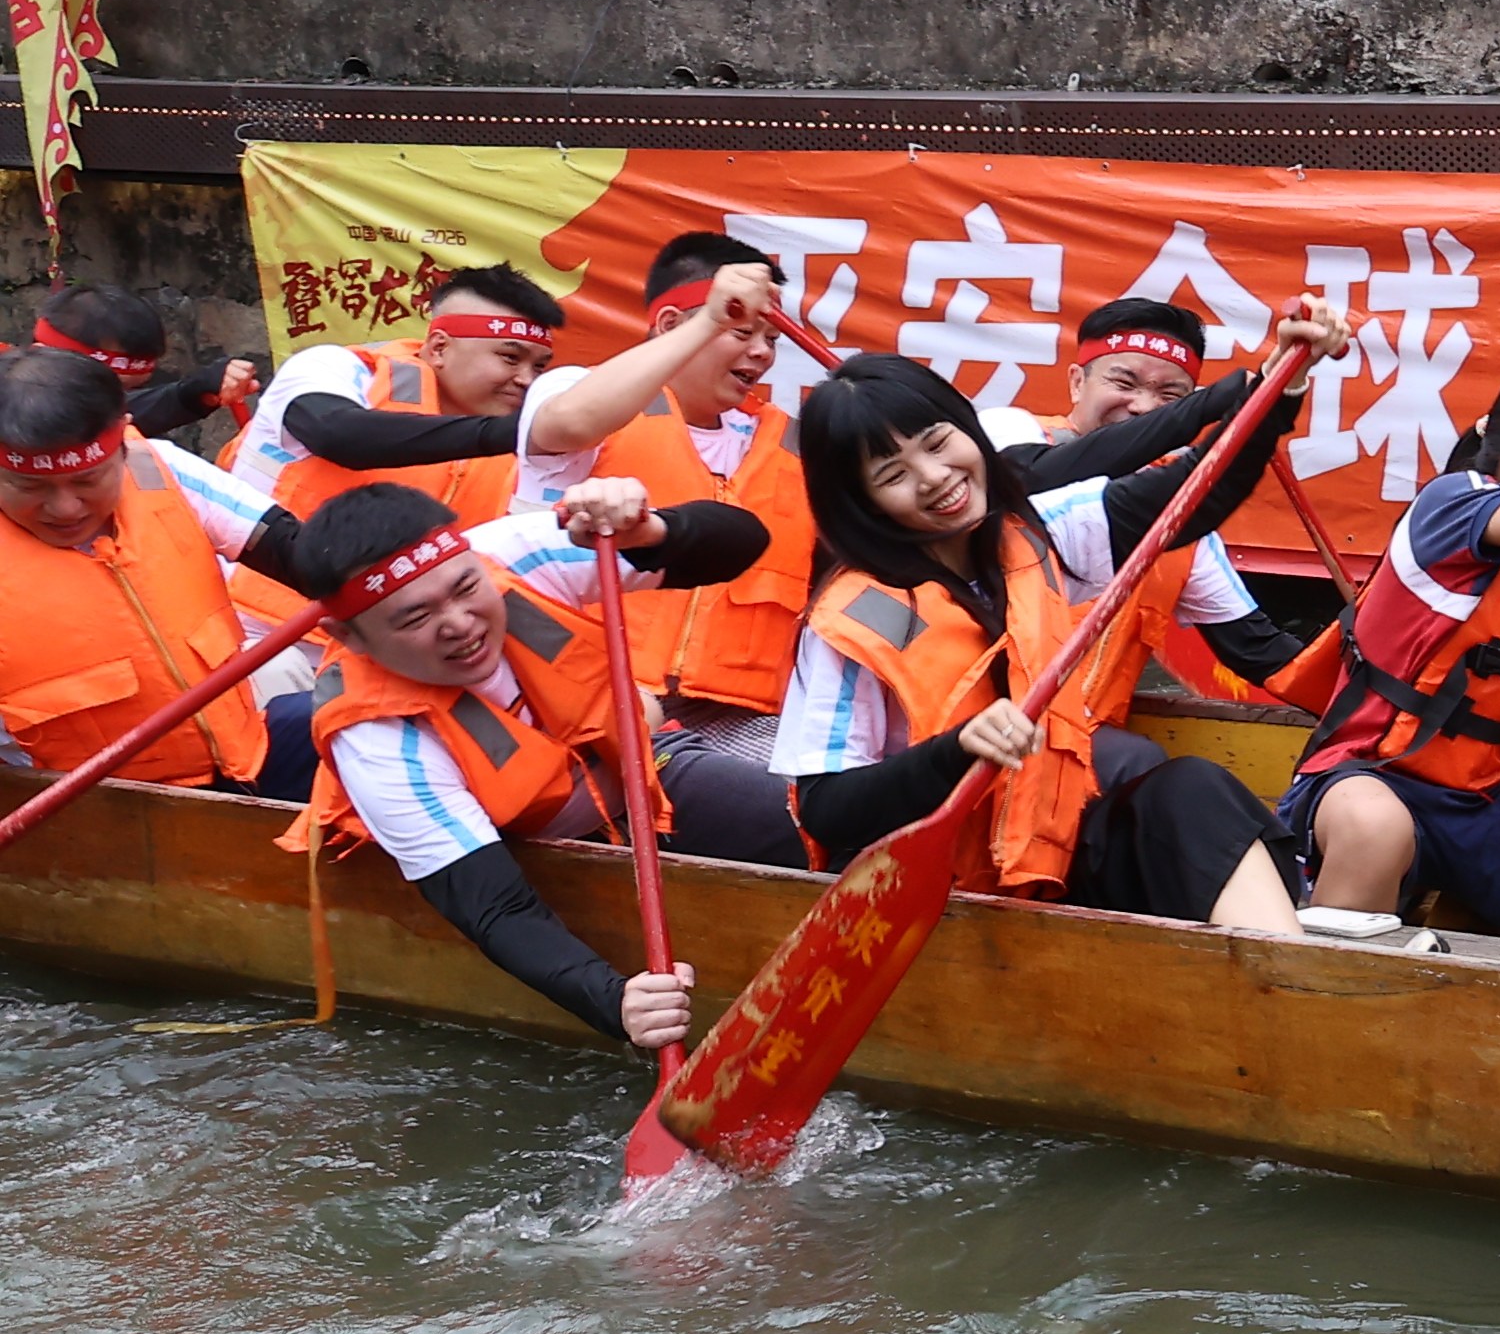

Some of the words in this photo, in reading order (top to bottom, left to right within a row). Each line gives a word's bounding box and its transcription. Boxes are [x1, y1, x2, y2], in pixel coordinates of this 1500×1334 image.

[1106, 333, 1188, 363] 中国佛照
[364, 530, 460, 595] 中国佛照
